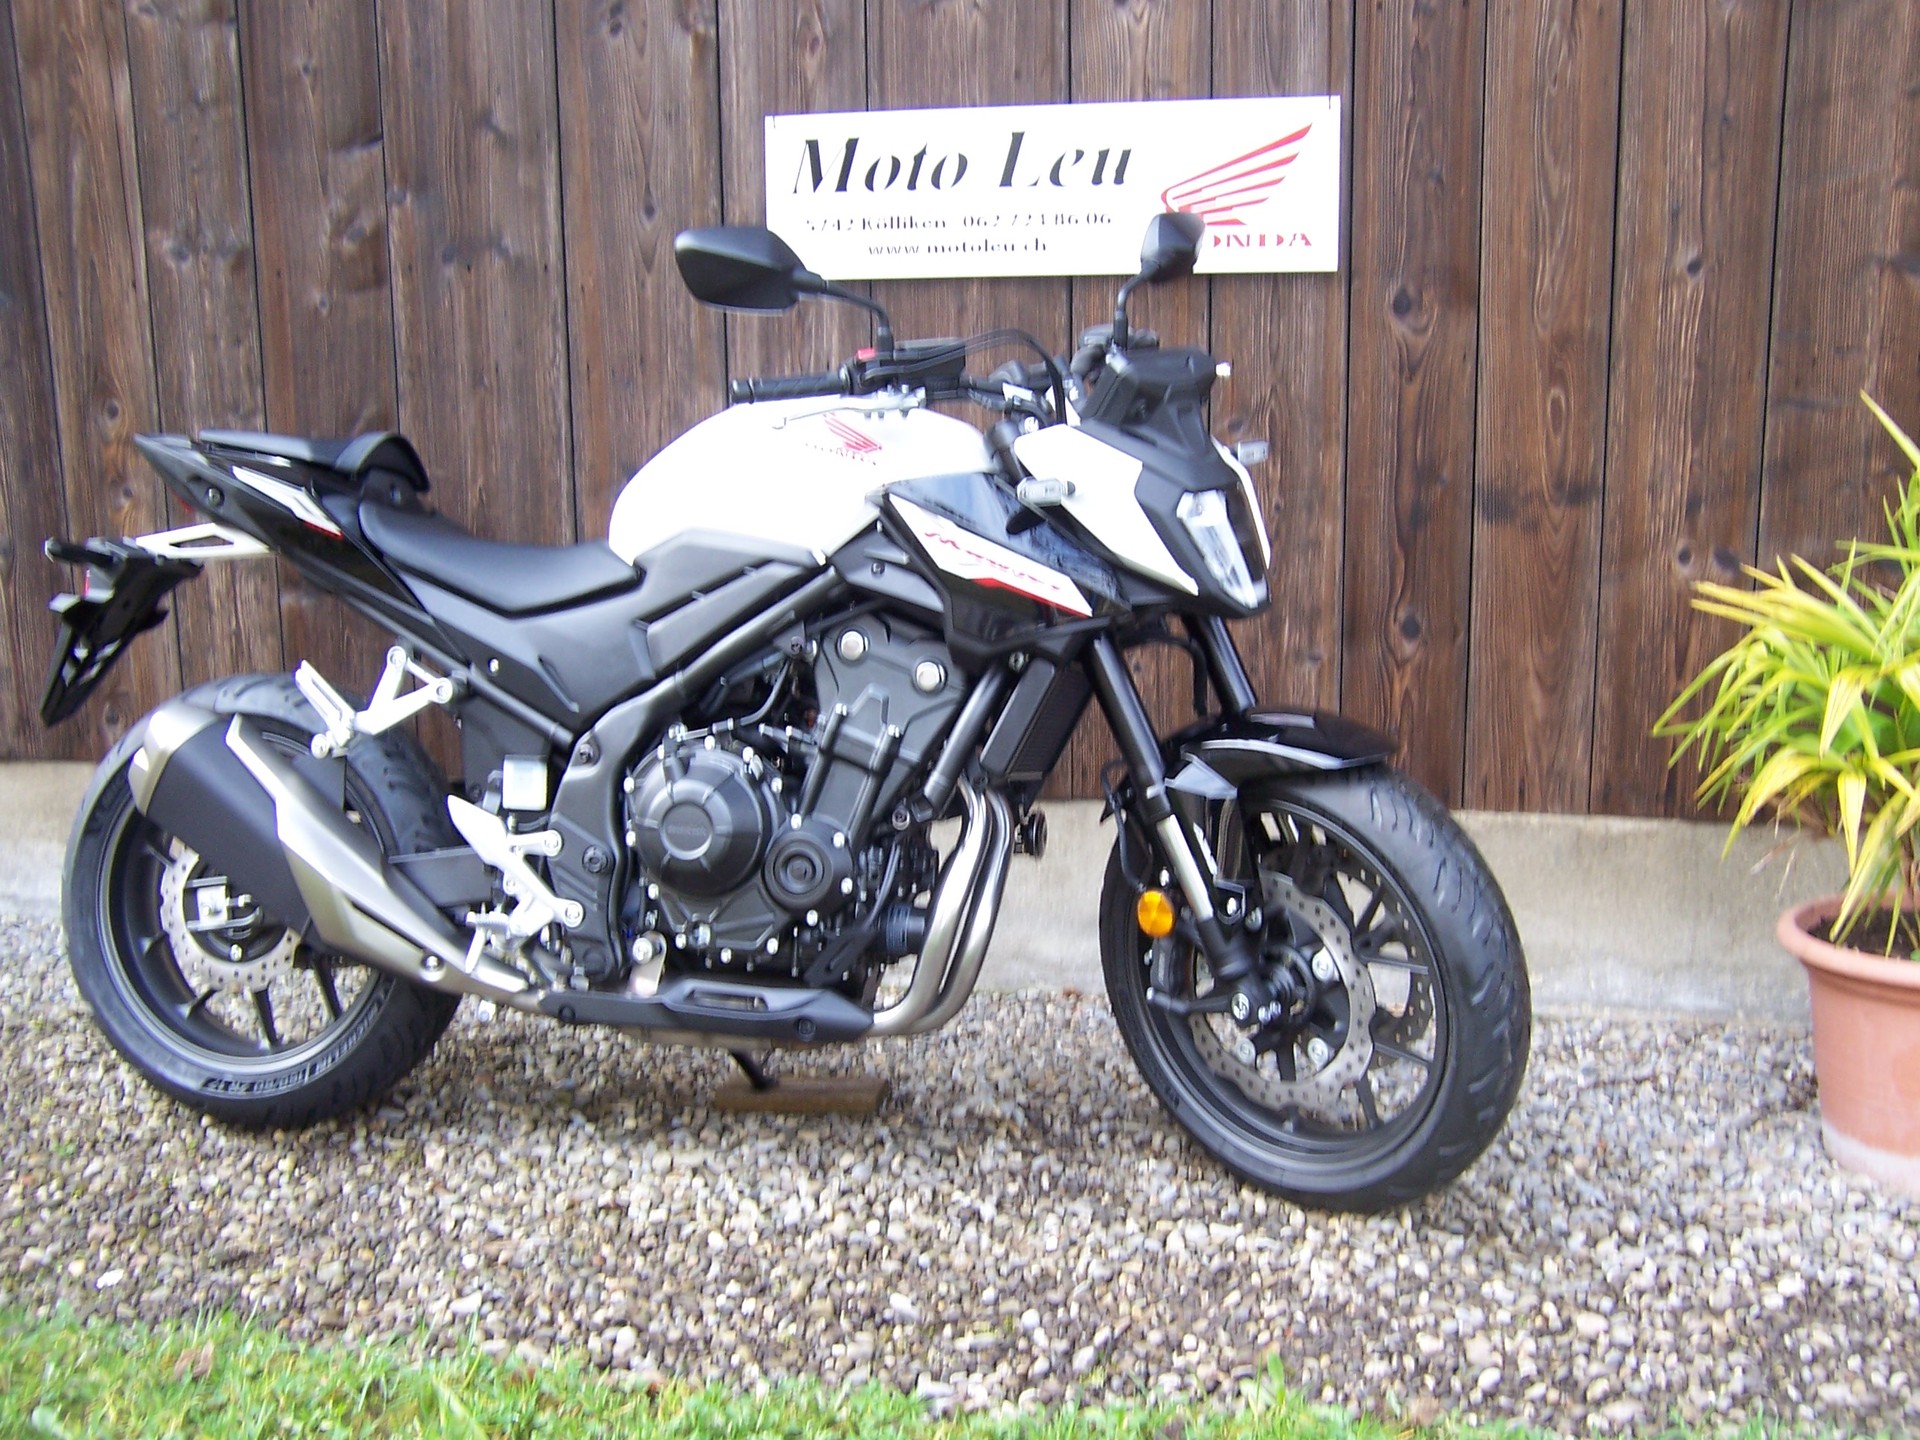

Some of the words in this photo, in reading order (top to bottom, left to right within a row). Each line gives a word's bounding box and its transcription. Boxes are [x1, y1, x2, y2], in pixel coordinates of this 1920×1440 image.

[792, 136, 969, 194] Moto
[998, 130, 1132, 189] Leu
[862, 214, 946, 231] Kölliken
[1086, 212, 1112, 225] 06
